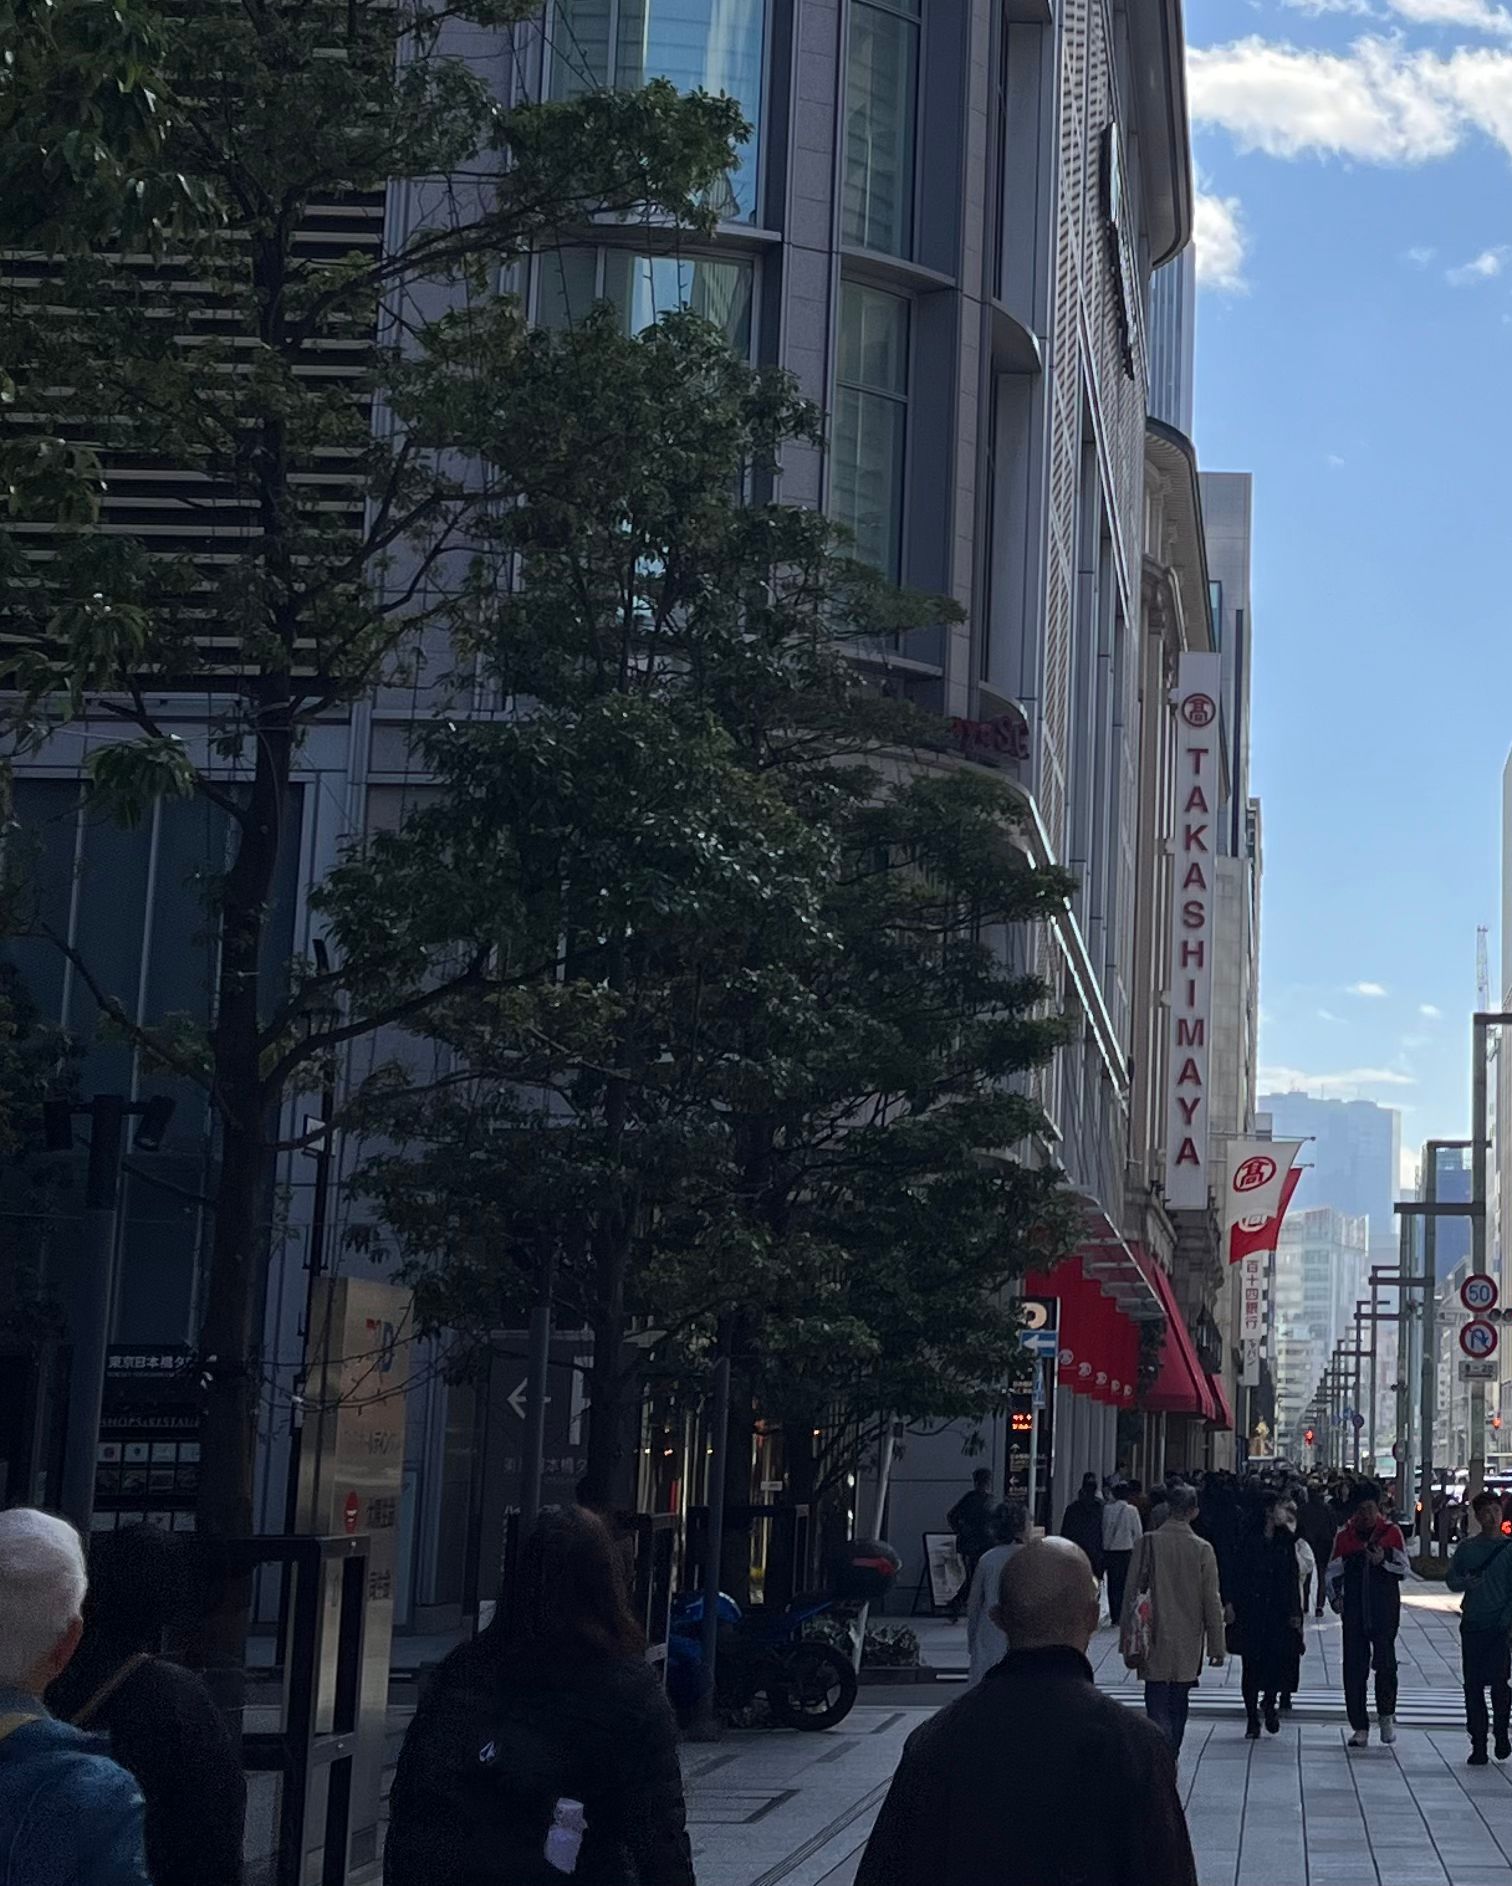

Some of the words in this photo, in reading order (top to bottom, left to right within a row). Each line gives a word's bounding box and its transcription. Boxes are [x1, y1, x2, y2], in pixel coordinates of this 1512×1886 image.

[1176, 748, 1209, 1166] TAKASHIMAYA
[1245, 1260, 1259, 1329] 百十四銀行
[1468, 1284, 1490, 1303] 50
